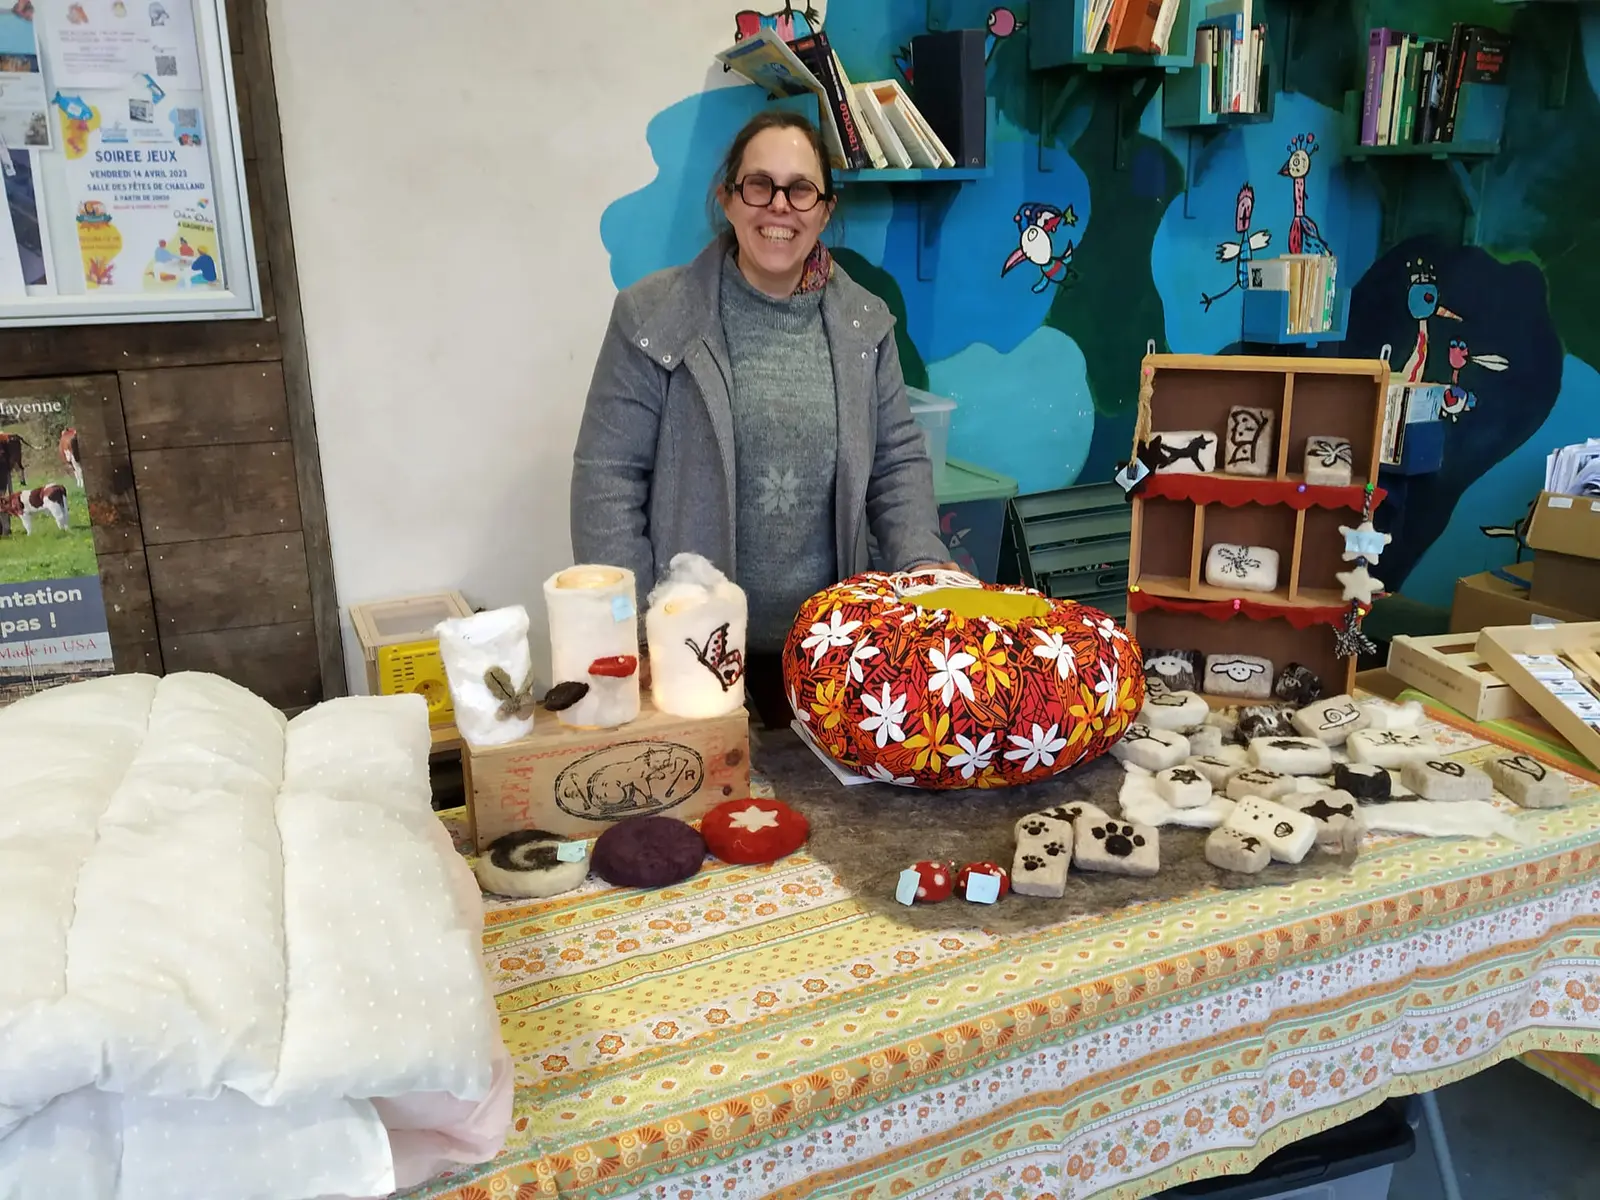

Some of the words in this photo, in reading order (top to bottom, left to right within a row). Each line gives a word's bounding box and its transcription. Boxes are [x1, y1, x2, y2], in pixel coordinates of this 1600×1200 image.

[95, 150, 142, 163] SOIREE
[147, 150, 178, 162] JEUX
[90, 170, 131, 179] VENDREDI
[133, 170, 142, 178] 14
[144, 170, 167, 178] AVRIL
[169, 169, 188, 178] 2023
[87, 183, 110, 191] SALLE
[128, 181, 152, 190] FÊTES
[153, 182, 163, 190] DE
[165, 181, 205, 190] CHAILLAND
[0, 618, 42, 638] pas
[49, 611, 57, 628] !
[43, 643, 57, 655] in
[62, 639, 97, 652] USA
